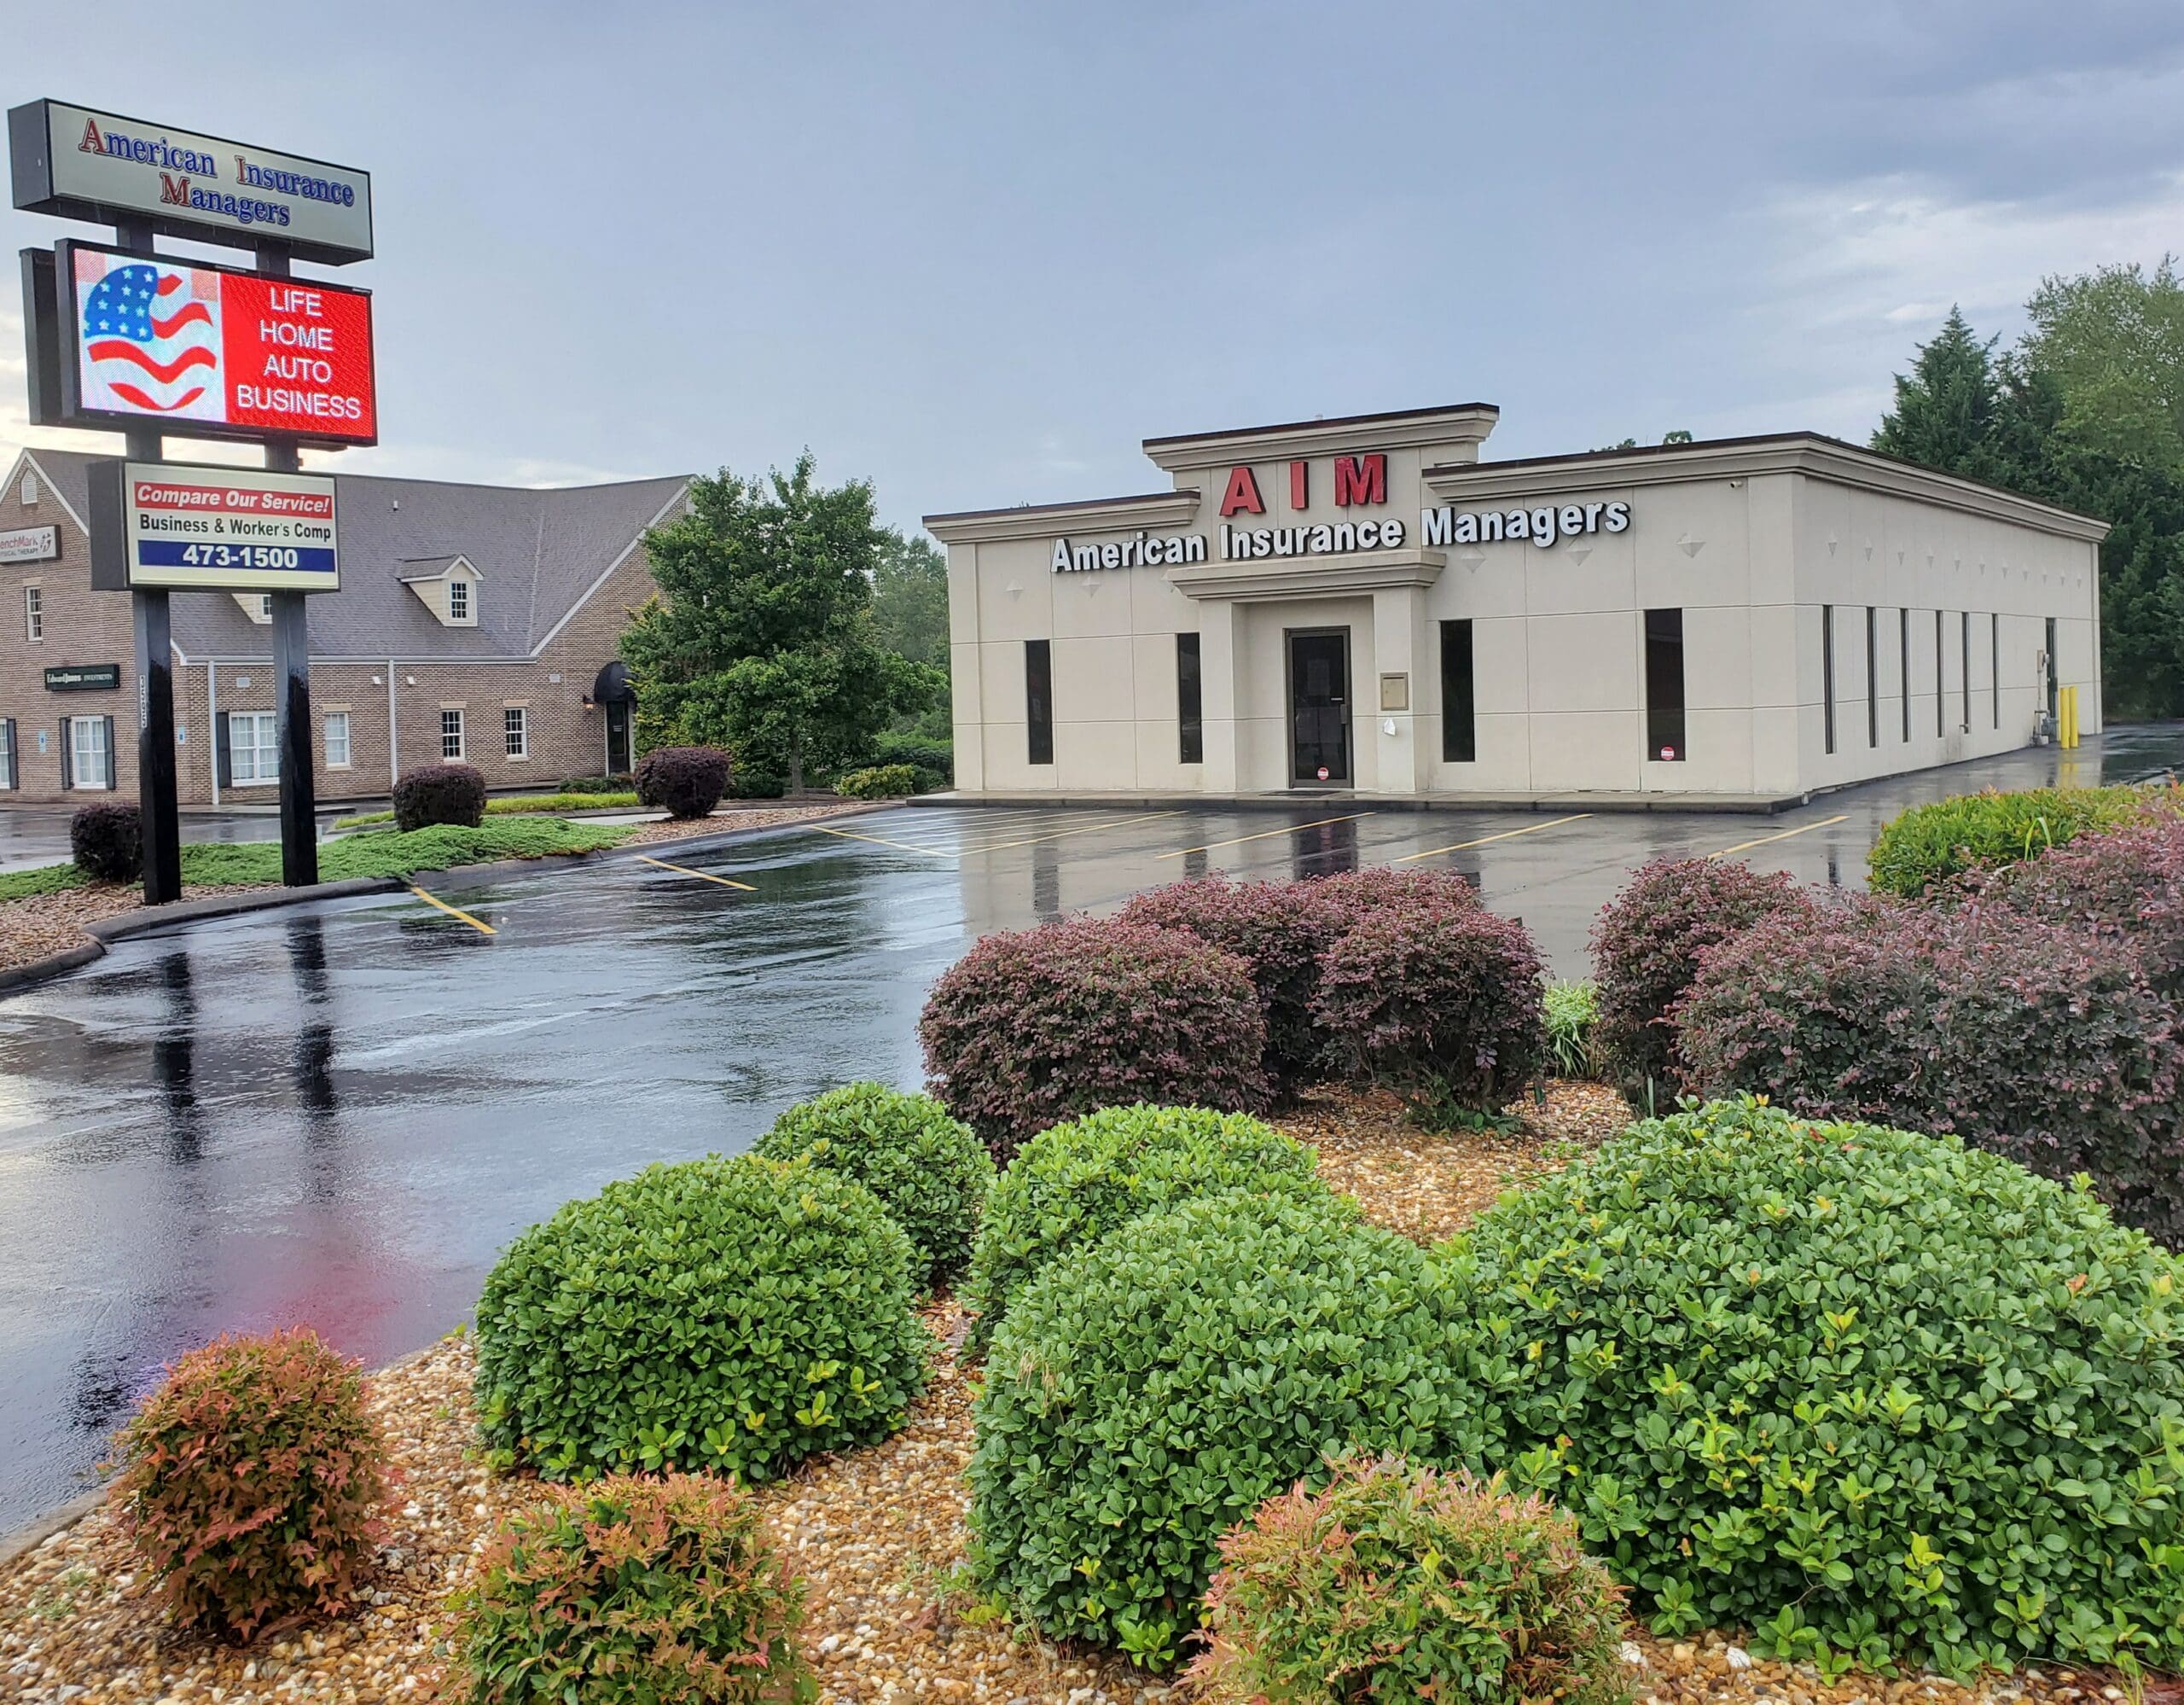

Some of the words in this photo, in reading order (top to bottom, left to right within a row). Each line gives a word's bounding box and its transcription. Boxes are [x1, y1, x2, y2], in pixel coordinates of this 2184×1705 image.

[78, 118, 218, 178] American
[235, 155, 355, 207] Insurance
[160, 172, 291, 226] Managers
[270, 286, 322, 317] LIFE
[259, 318, 334, 351] HOME
[263, 356, 333, 384] AUTO
[236, 384, 361, 420] BUSINESS
[136, 484, 222, 508] Compare
[225, 490, 258, 509] Our
[261, 492, 330, 513] Service!
[140, 513, 209, 533] Business
[214, 518, 225, 533] &
[229, 518, 290, 538] Worker's
[294, 523, 331, 542] Comp
[1049, 532, 1208, 573] American
[1219, 518, 1407, 560] Insurance
[1420, 500, 1633, 549] Managers
[183, 544, 299, 568] 473-1500
